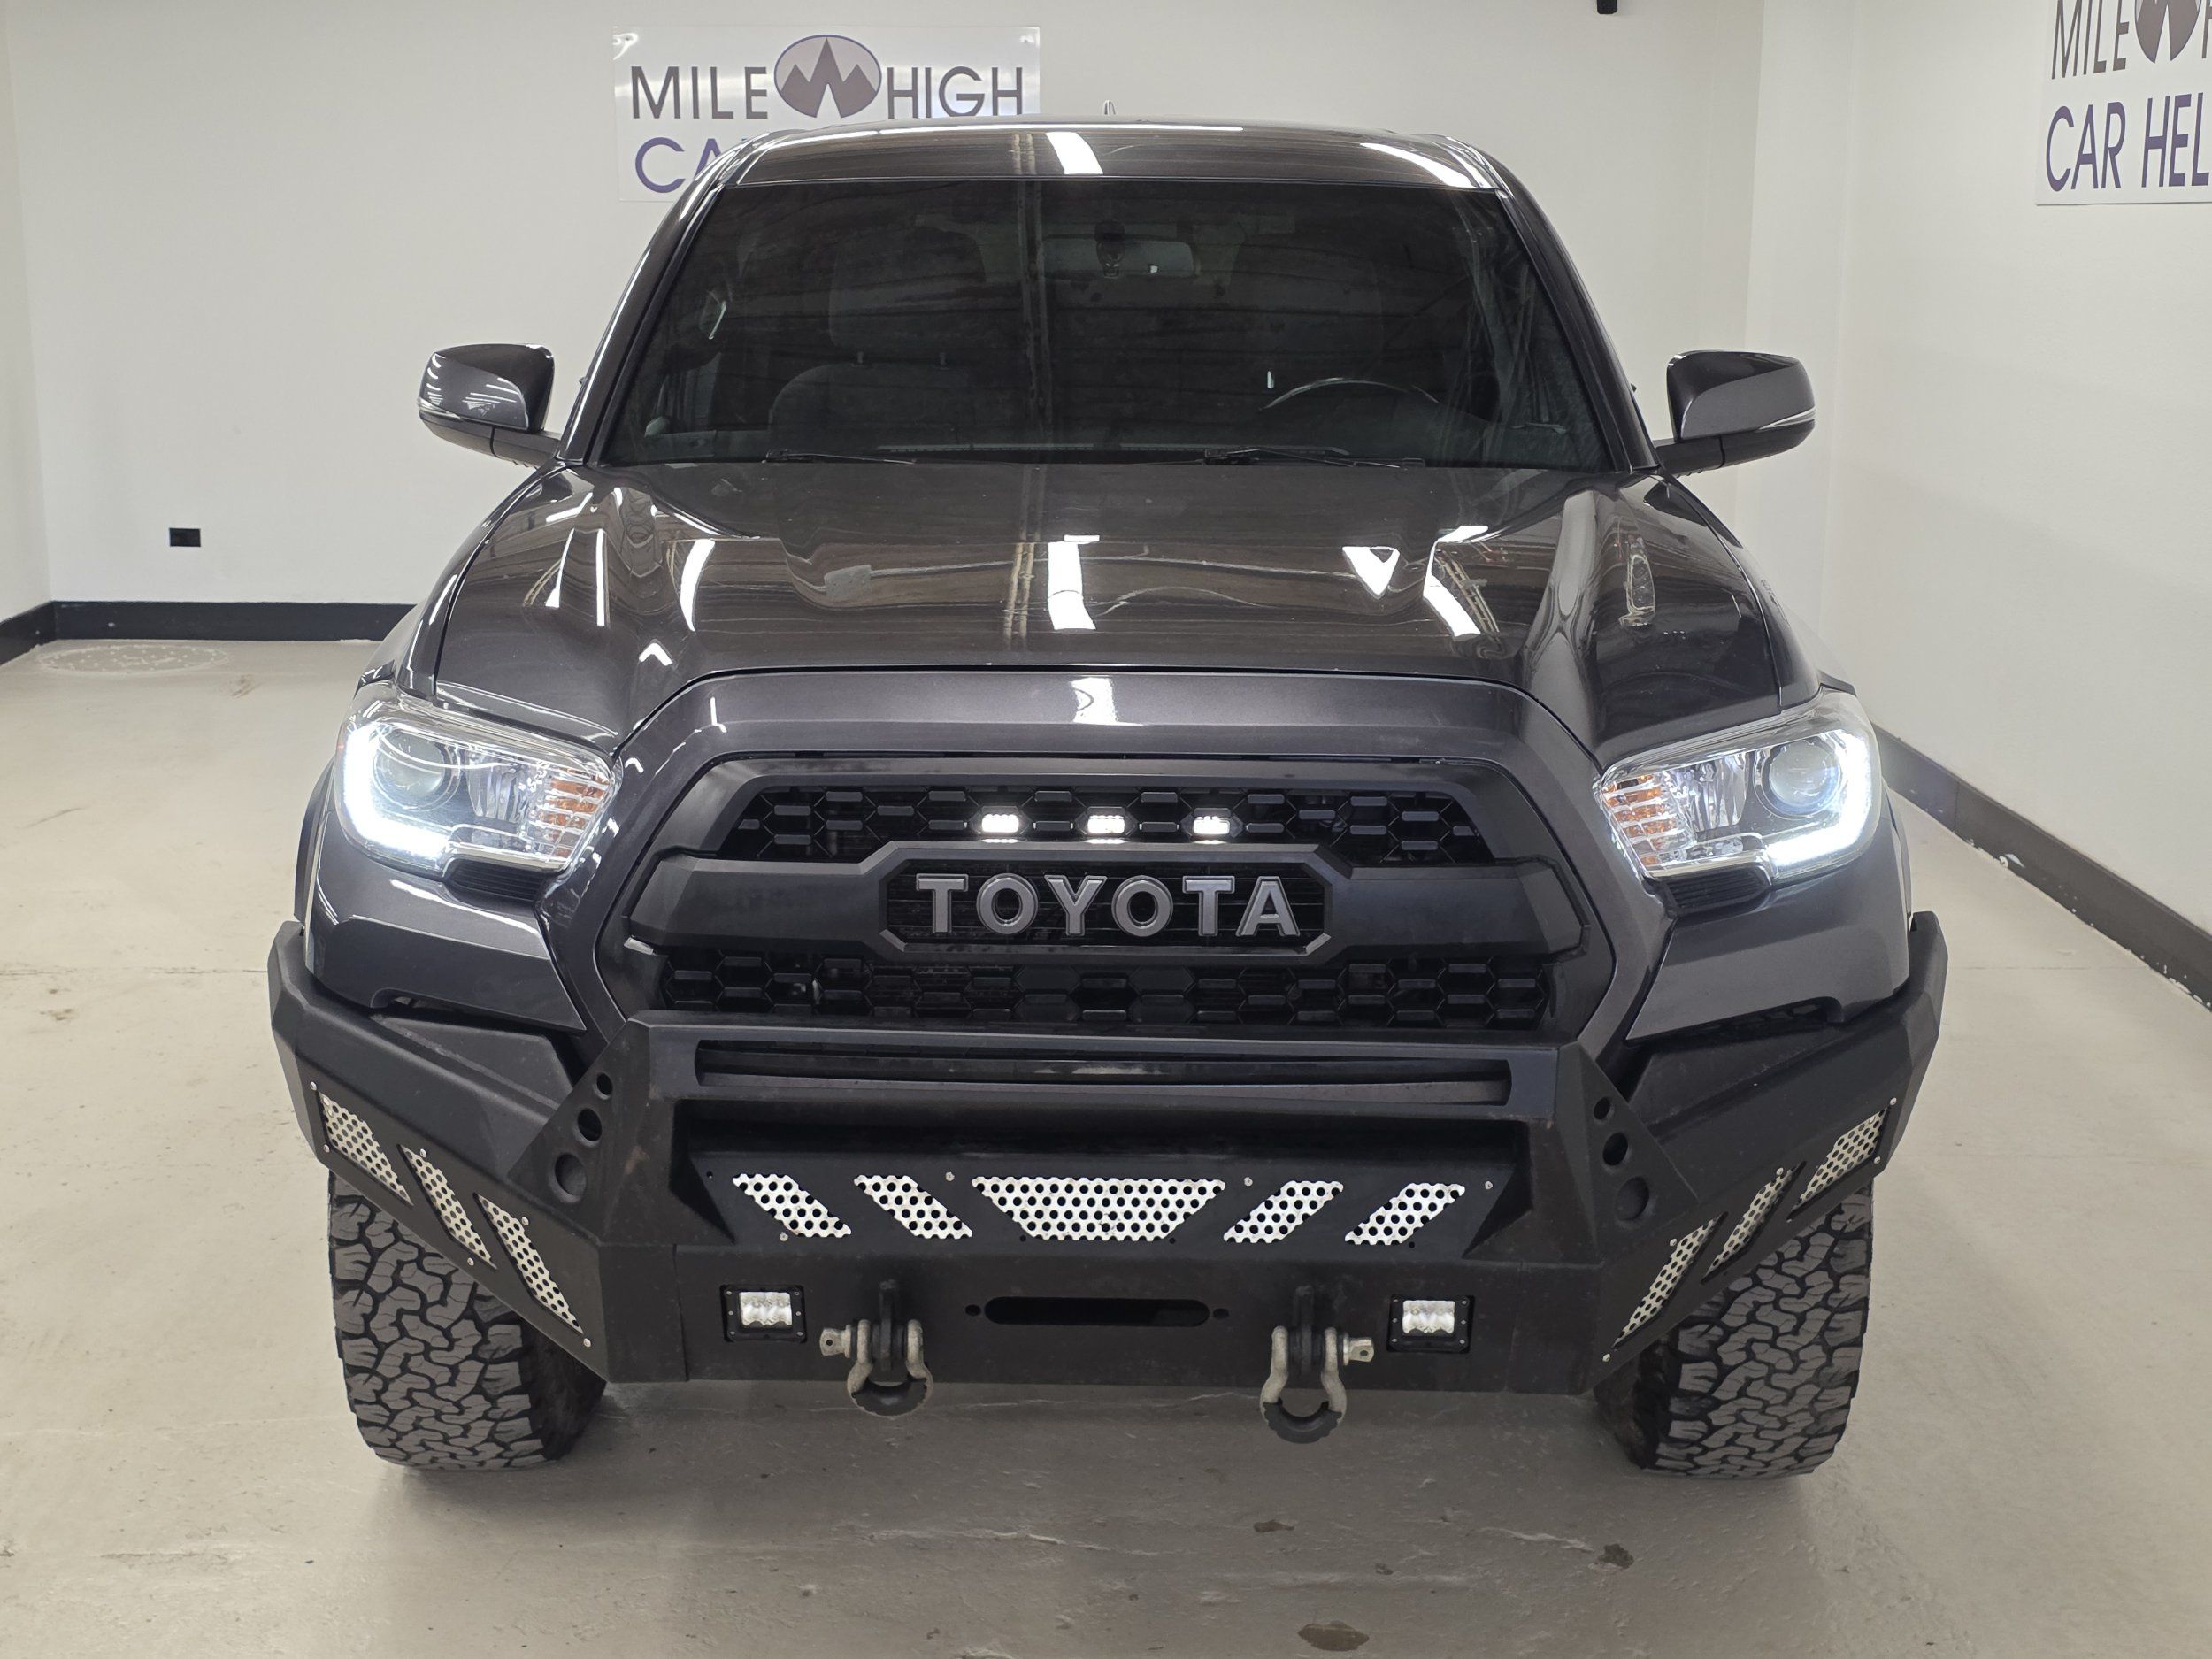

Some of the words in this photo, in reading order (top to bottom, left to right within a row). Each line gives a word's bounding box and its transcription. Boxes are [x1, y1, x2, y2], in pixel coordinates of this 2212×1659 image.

[2051, 0, 2130, 80] MILE
[630, 65, 768, 119] MILE
[887, 65, 1023, 119] HIGH
[634, 136, 746, 194] CA
[2046, 101, 2126, 192] CAR
[915, 872, 1301, 937] TOYOTA
